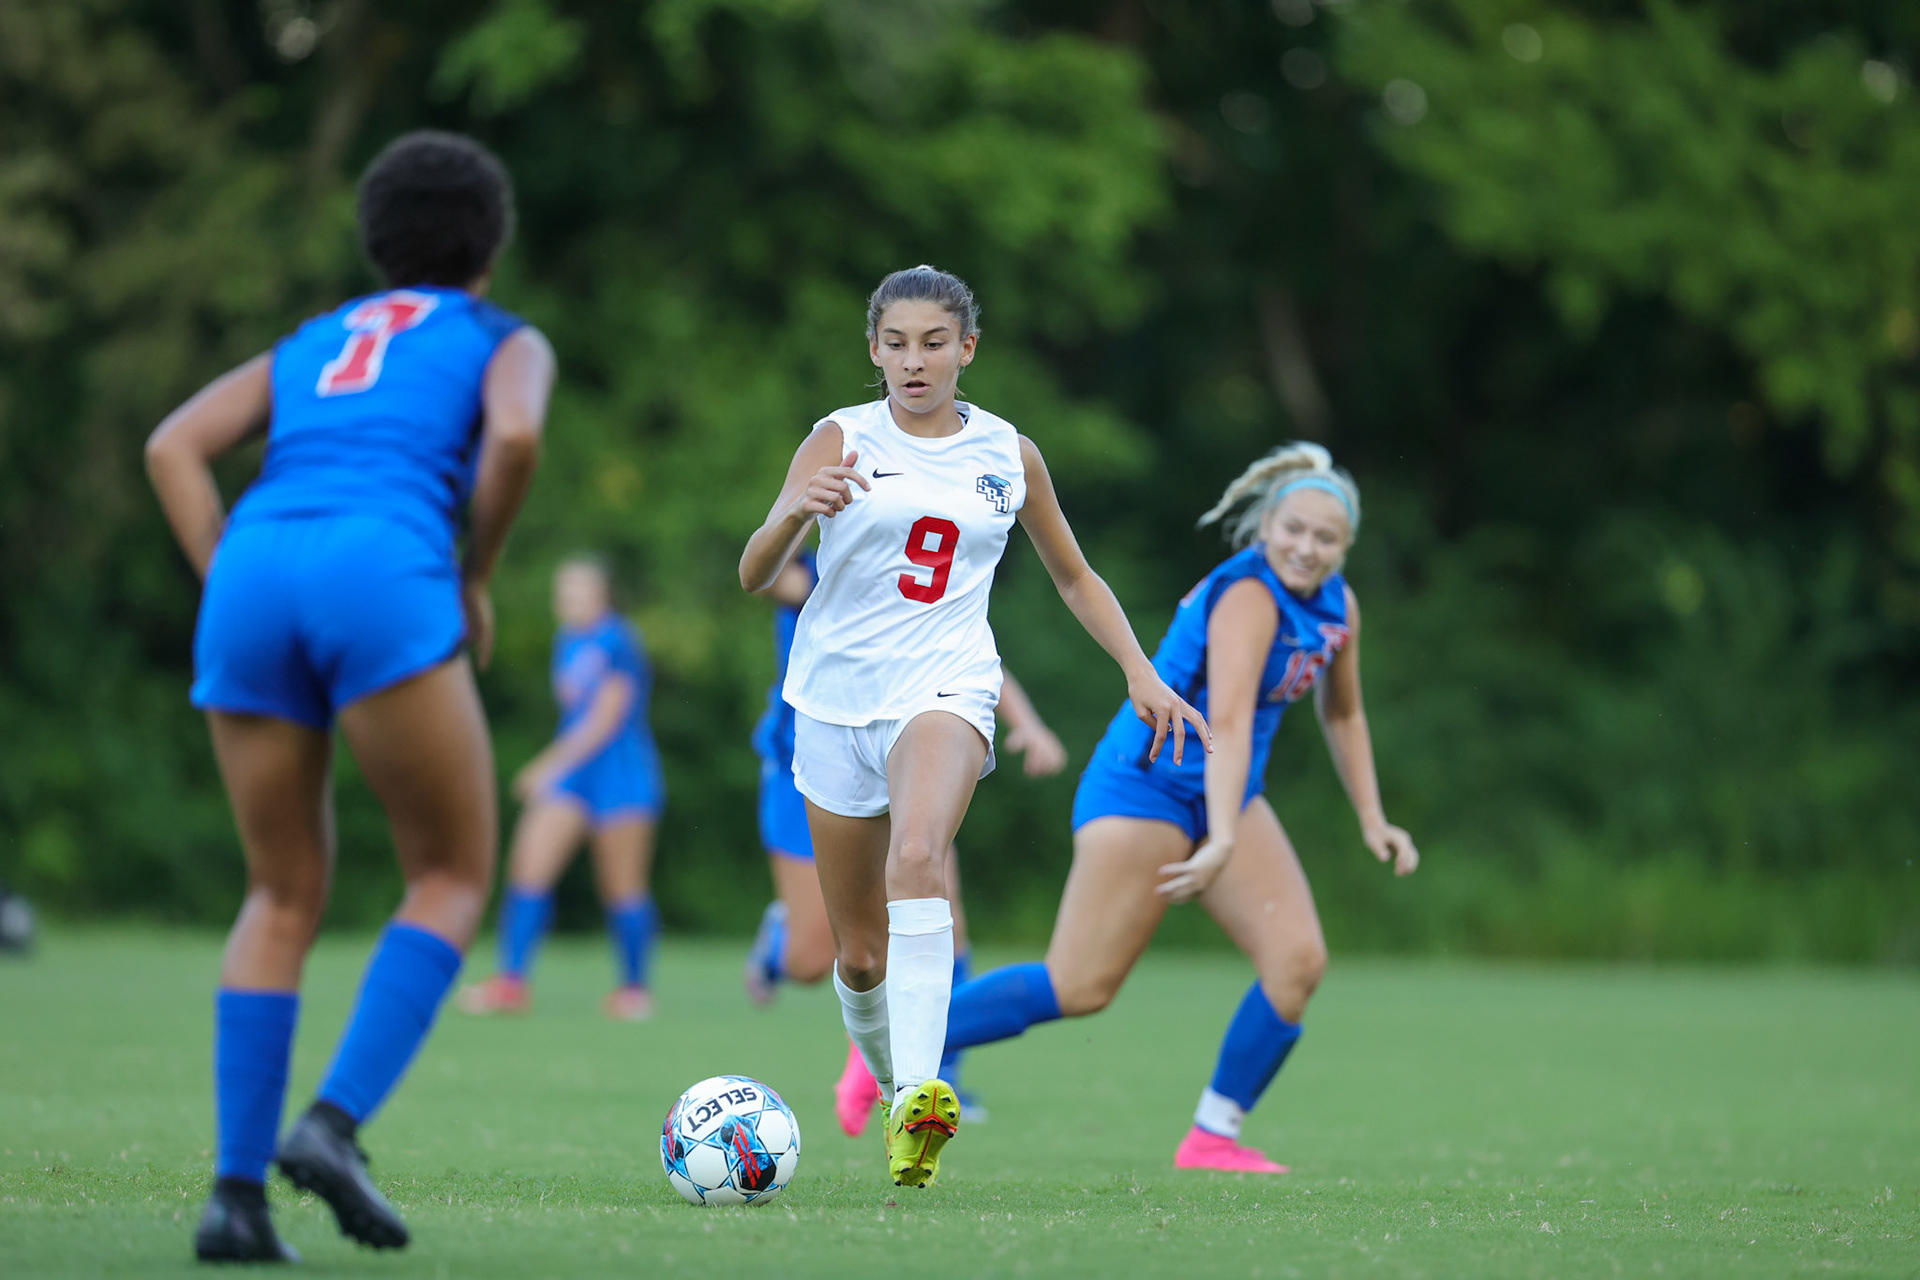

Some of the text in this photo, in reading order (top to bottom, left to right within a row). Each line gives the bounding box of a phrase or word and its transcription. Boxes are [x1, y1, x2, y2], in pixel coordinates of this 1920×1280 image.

[315, 289, 439, 398] 7
[977, 477, 1010, 513] SBA
[897, 515, 961, 604] 9
[686, 1087, 758, 1133] SELECT
